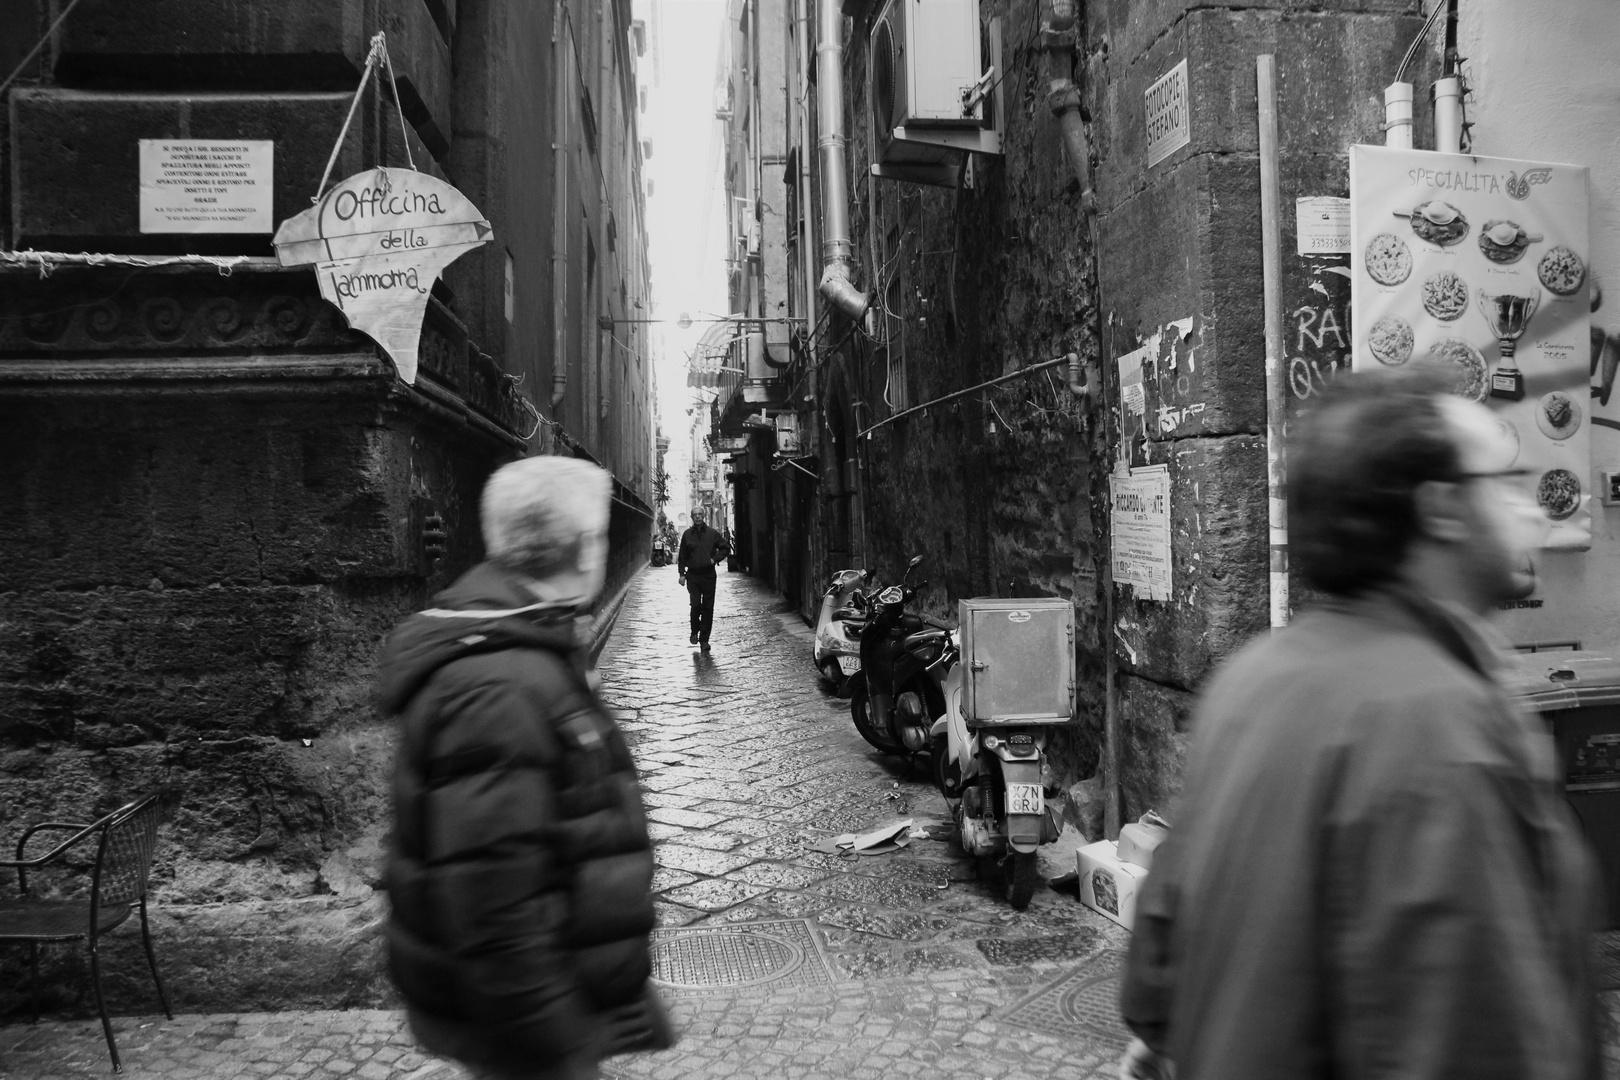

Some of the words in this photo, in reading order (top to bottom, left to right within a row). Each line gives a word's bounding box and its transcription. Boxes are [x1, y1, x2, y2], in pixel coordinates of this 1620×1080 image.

[1145, 70, 1180, 118] FOTOCOPIE
[1147, 104, 1180, 147] STEFANO
[1408, 168, 1504, 194] SPECIALITA'
[334, 186, 446, 221] Officina
[380, 229, 428, 250] della
[1012, 785, 1039, 799] X7N
